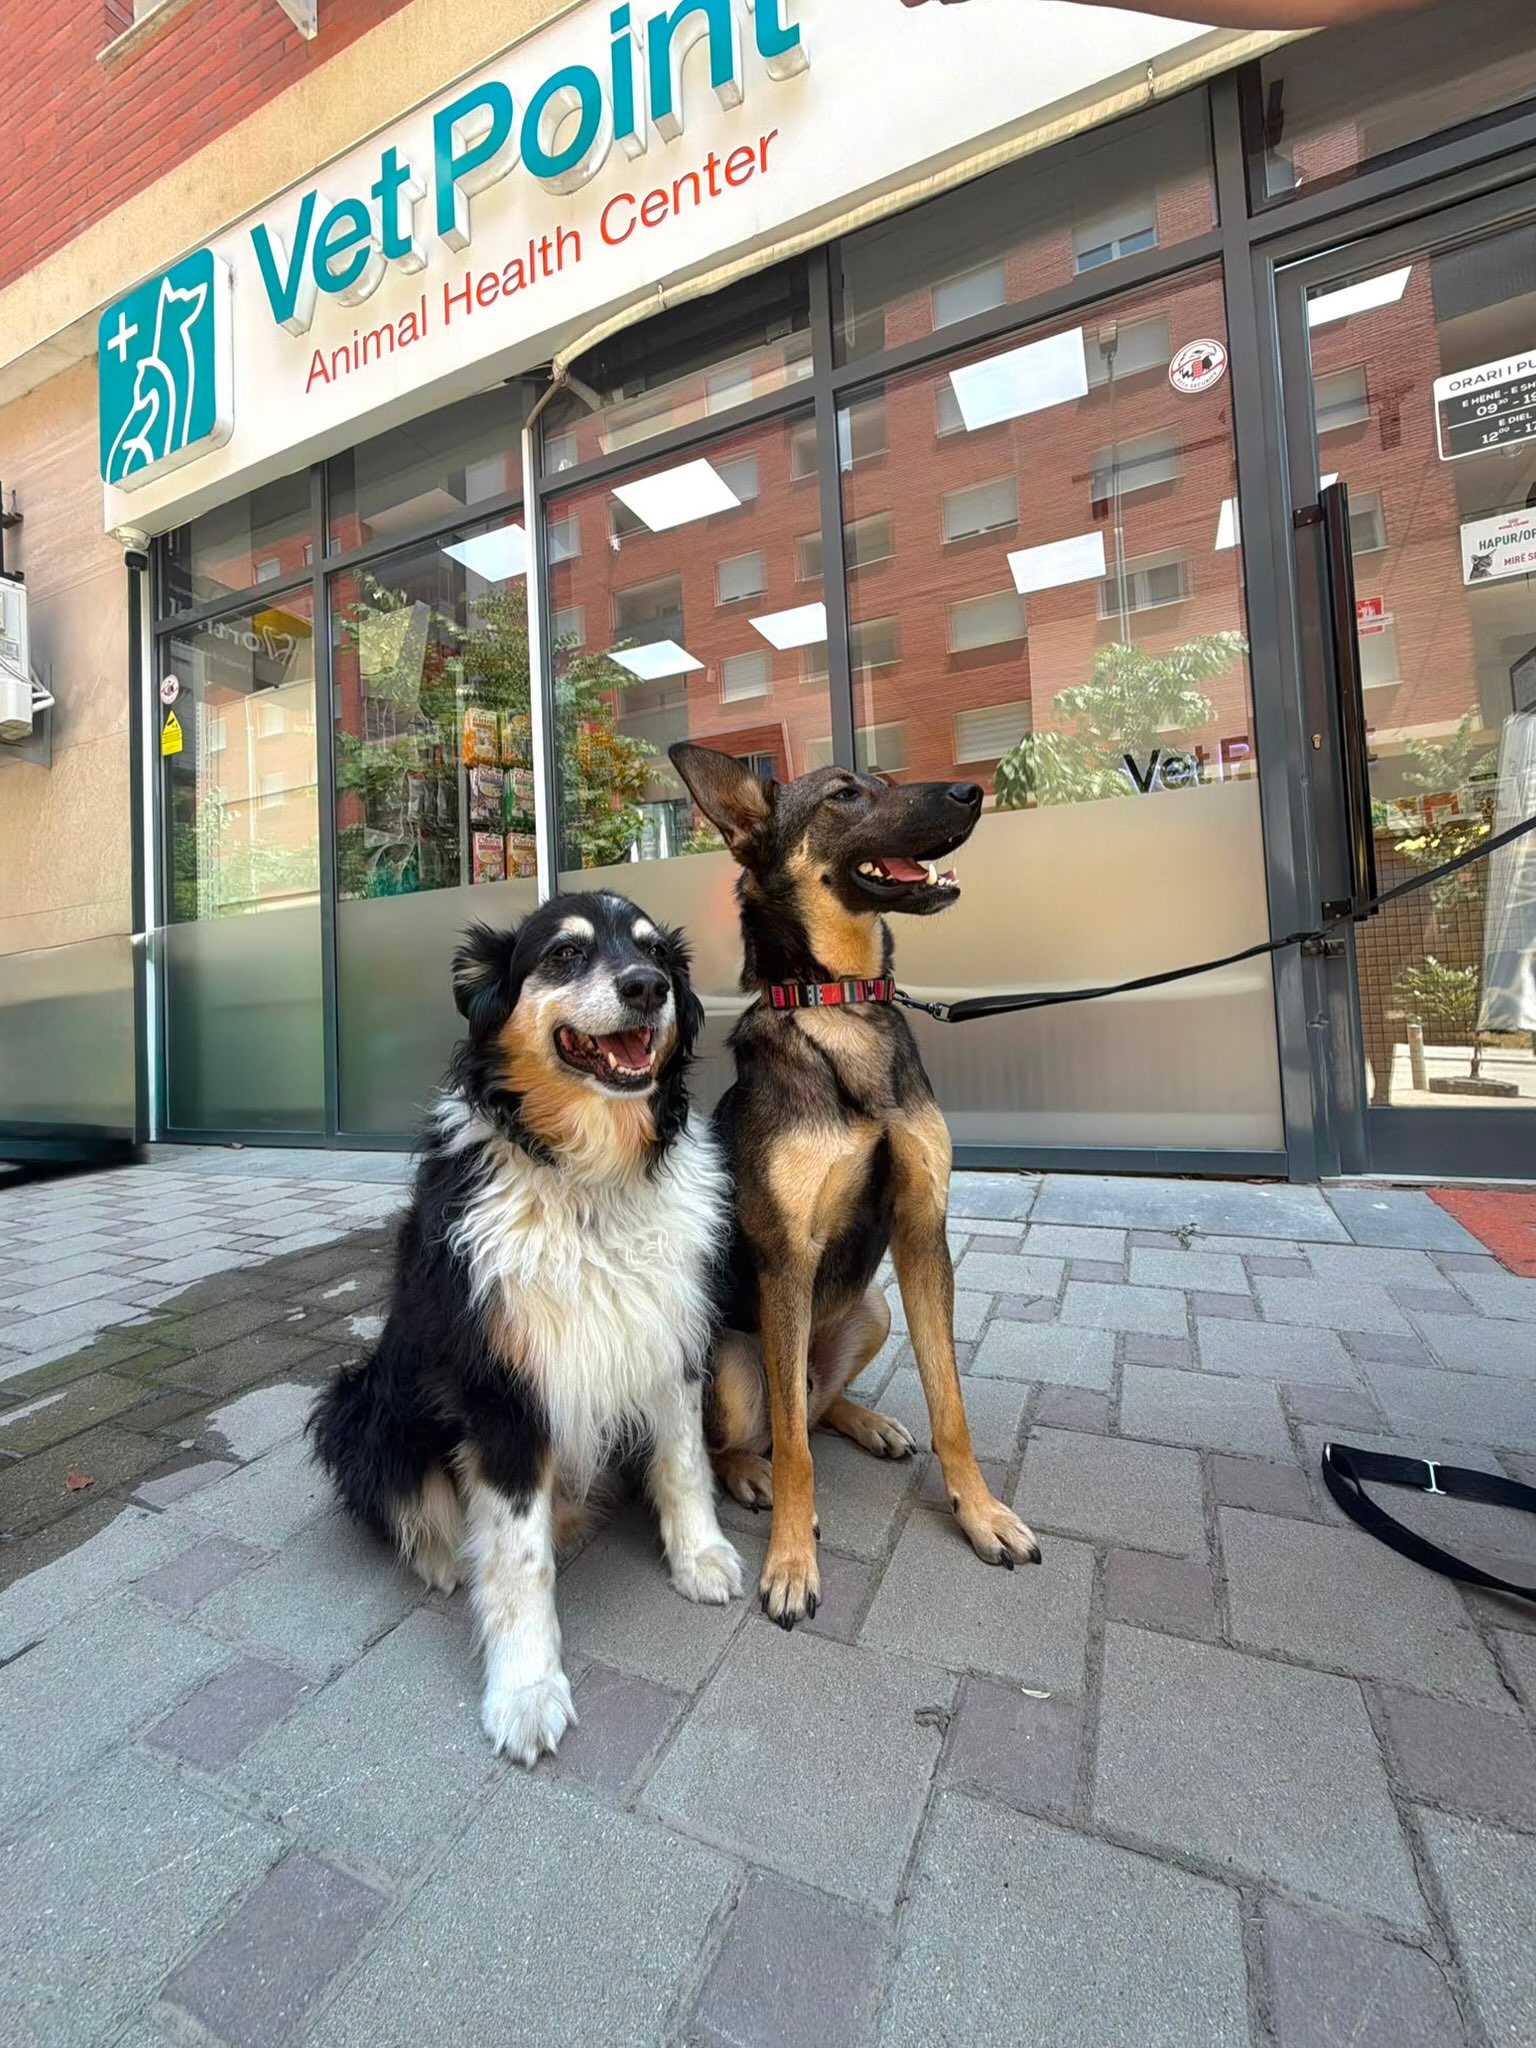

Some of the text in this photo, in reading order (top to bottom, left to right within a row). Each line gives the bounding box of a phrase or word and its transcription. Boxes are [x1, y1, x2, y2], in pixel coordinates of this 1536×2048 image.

[305, 128, 778, 394] Animal Health Center
[1448, 367, 1503, 391] ORARI
[1462, 399, 1469, 408] E
[1510, 385, 1519, 395] E
[1498, 412, 1533, 427] E DIEL
